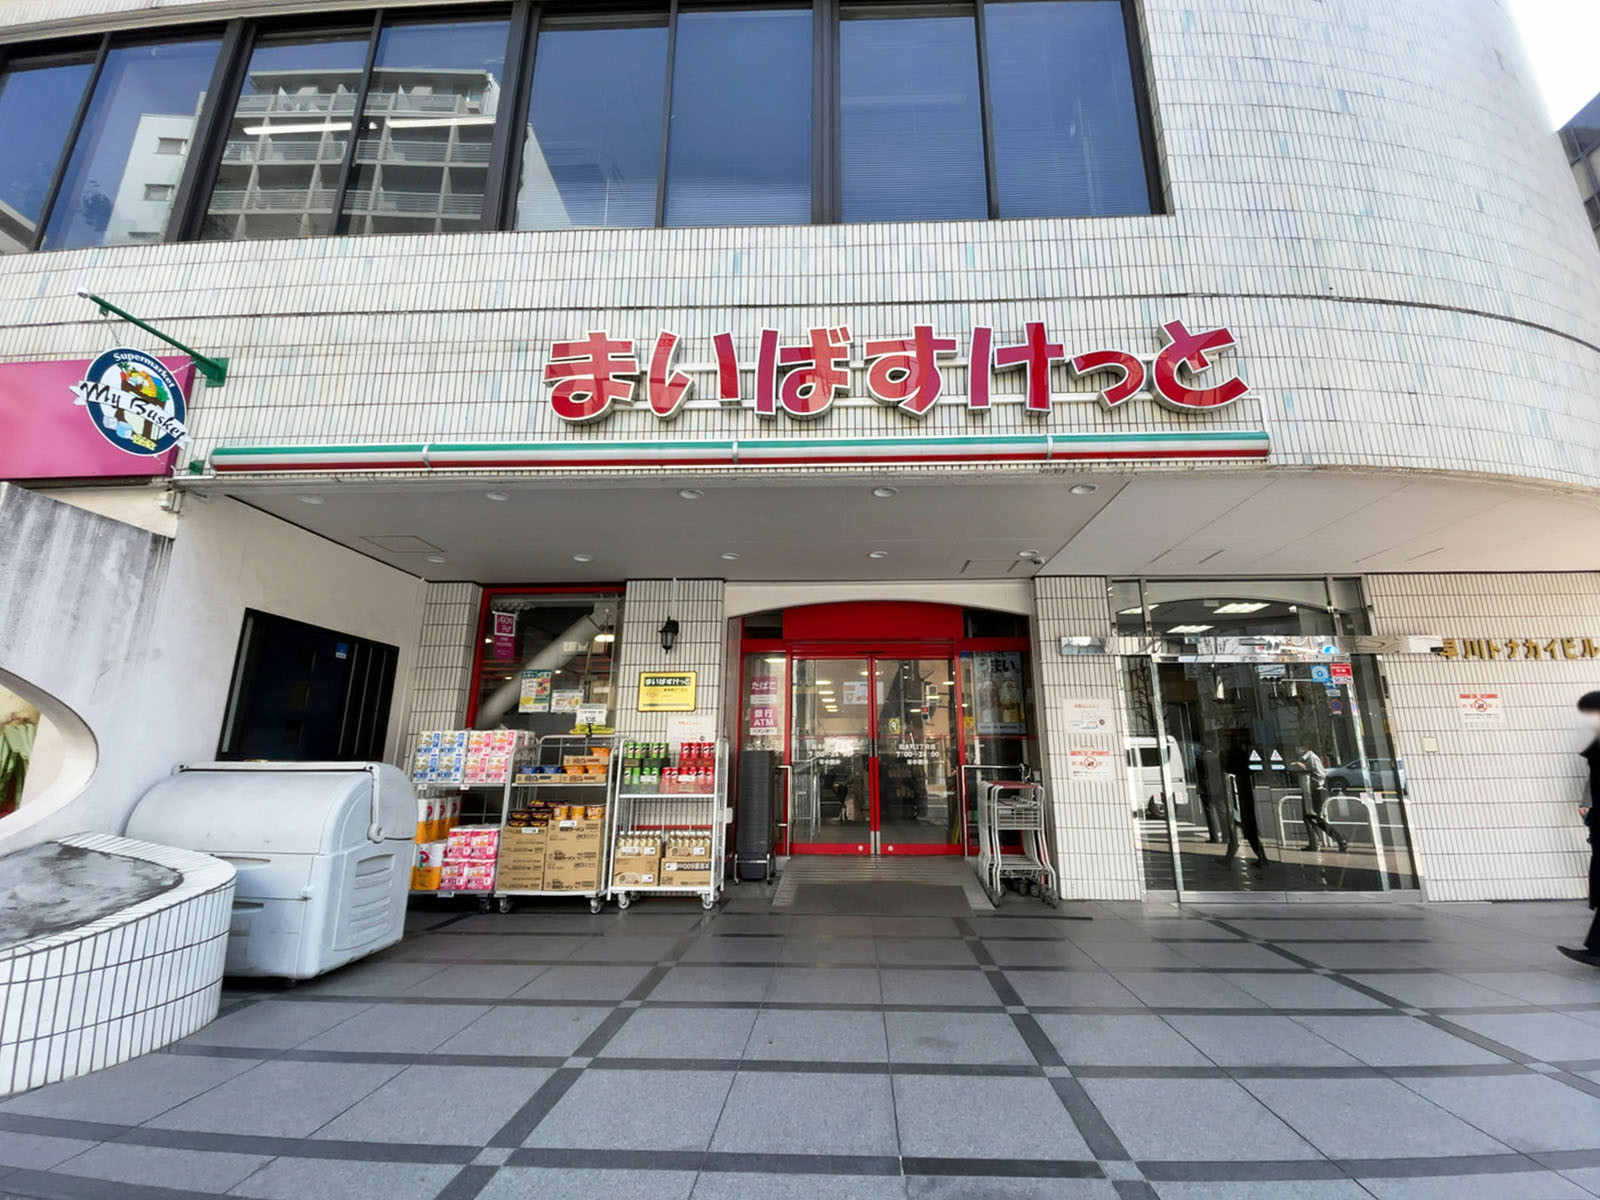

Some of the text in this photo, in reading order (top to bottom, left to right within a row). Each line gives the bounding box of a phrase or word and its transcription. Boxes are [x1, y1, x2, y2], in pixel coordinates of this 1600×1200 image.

[113, 352, 176, 388] Supermarket
[543, 320, 1252, 424] まいばすけっと
[80, 382, 186, 439] My Basket
[751, 681, 776, 690] たばこ
[753, 719, 774, 727] ATM
[754, 709, 773, 718] 銀行
